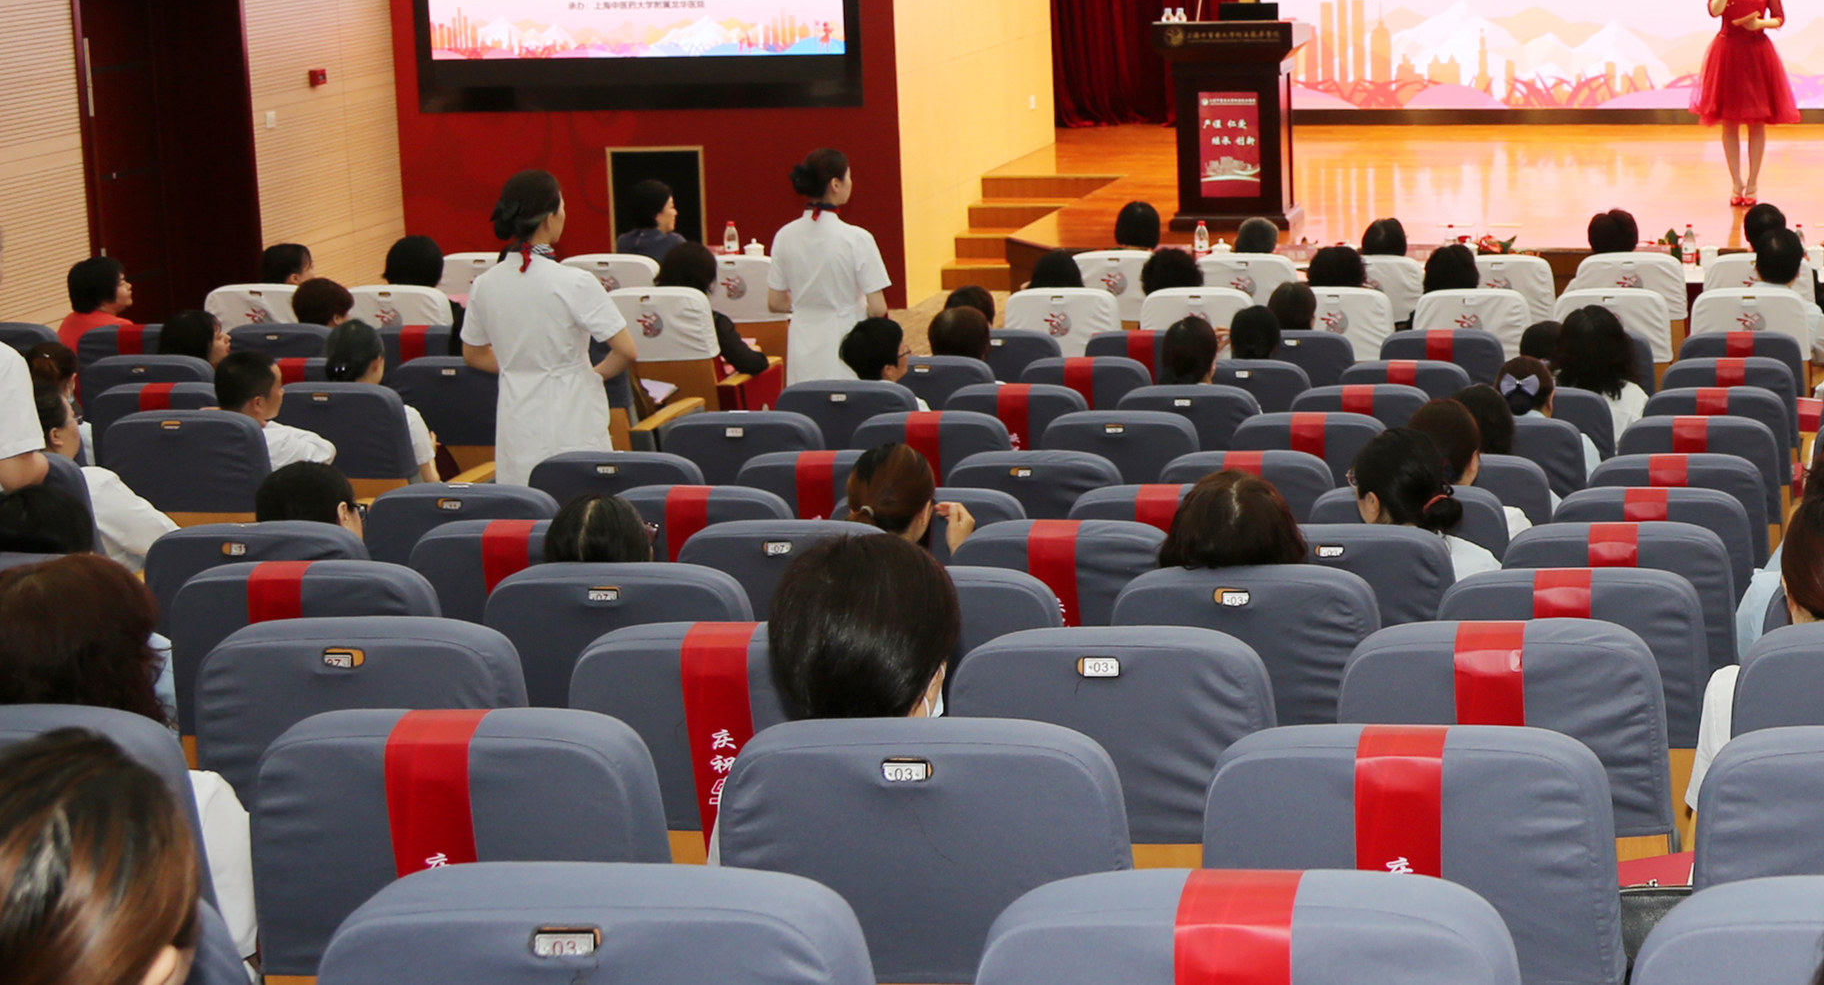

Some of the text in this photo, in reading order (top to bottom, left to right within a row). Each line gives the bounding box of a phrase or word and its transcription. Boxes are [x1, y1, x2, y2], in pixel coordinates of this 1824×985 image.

[1093, 661, 1109, 672] 03
[893, 767, 913, 781] 03
[552, 939, 578, 955] 03
